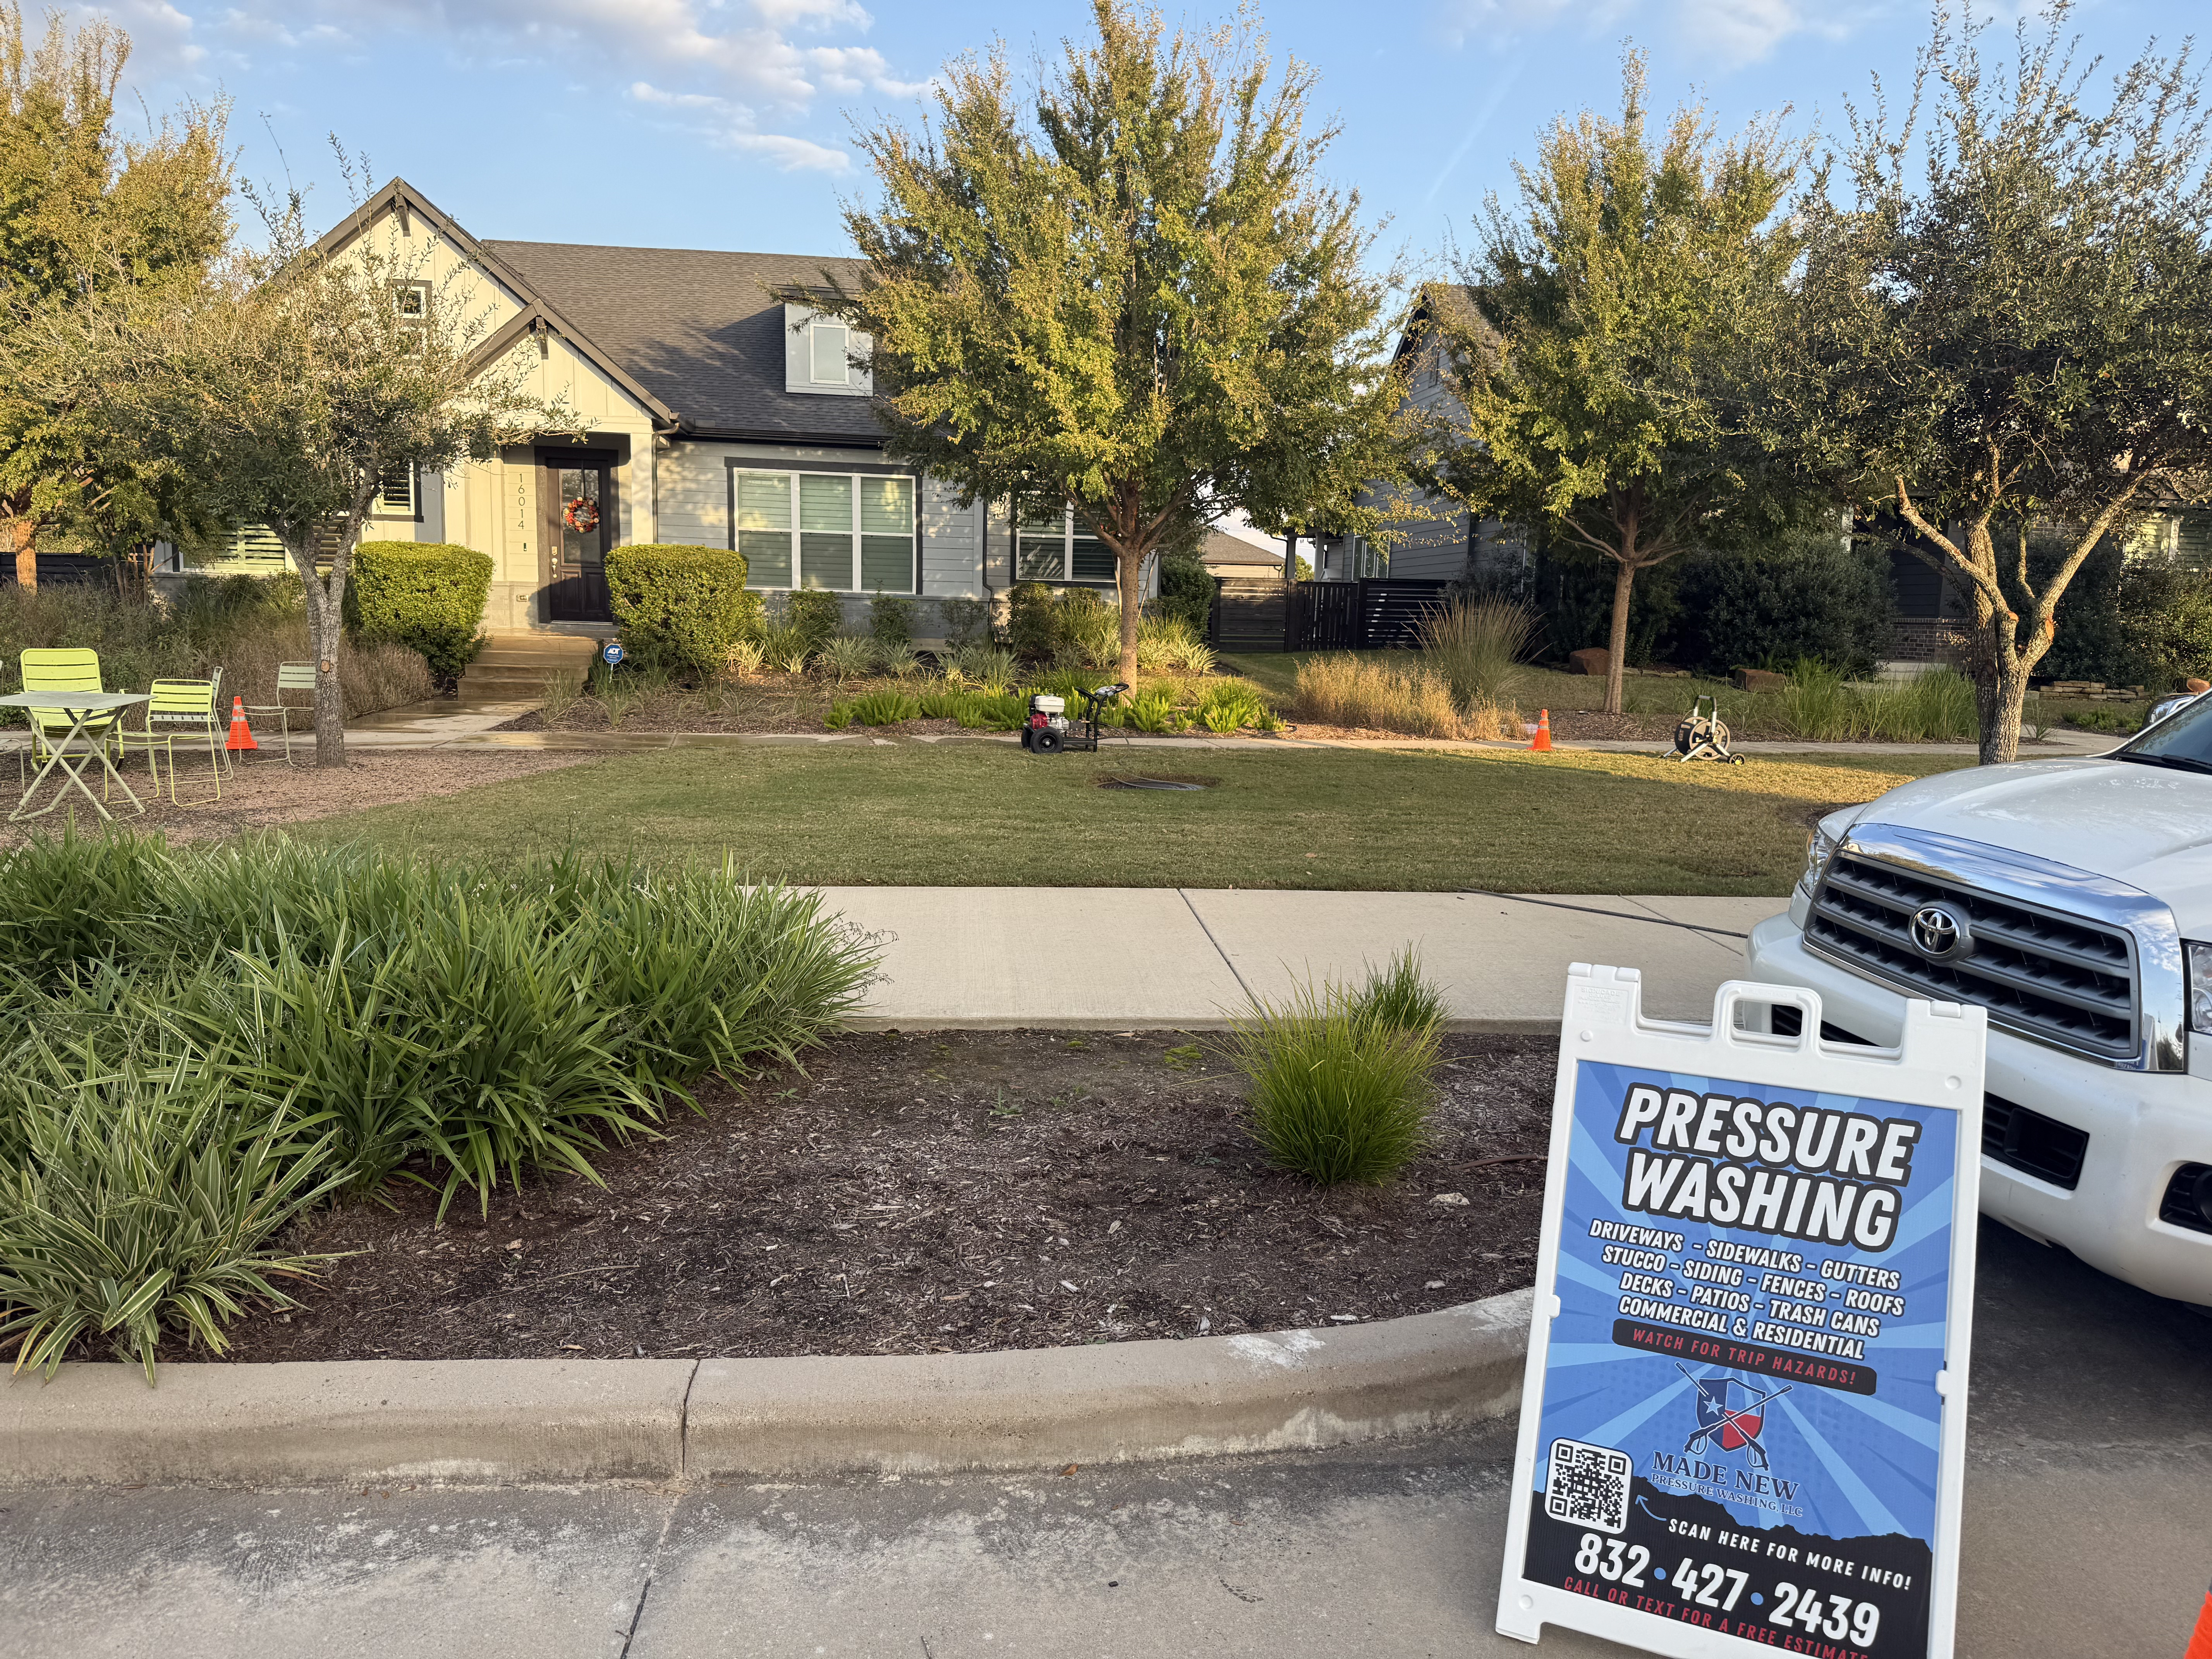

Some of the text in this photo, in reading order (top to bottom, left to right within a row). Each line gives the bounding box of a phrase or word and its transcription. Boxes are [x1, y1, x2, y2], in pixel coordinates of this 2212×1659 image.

[1620, 1087, 1915, 1180] PRESSURE
[1627, 1152, 1895, 1246] WASHING
[1589, 1219, 1683, 1252] DRIVEWAYS
[1706, 1240, 1802, 1272] SIDEWALKS
[1821, 1260, 1899, 1290] GUTTERS
[1602, 1245, 1666, 1272] STUCCO
[1683, 1260, 1742, 1286] SIDING
[1761, 1274, 1826, 1301] FENCES
[1845, 1289, 1905, 1316] ROOFS
[1619, 1296, 1864, 1358] COMMERCIAL & RESIDENTIAL
[1620, 1273, 1673, 1297] DECKS
[1690, 1286, 1750, 1312] PATIOS
[1770, 1300, 1826, 1327] TRASH
[1831, 1311, 1879, 1336] CANS
[1633, 1328, 1856, 1385] WATCH FOR TRIP HAZARDS!
[1651, 1474, 1803, 1517] PRESSURE WASHING, LLC
[1652, 1451, 1799, 1500] MADE NEW
[1669, 1518, 1911, 1590] SCAN HERE FOR MORE INFO!
[1564, 1576, 1599, 1598] CALL
[1607, 1588, 1628, 1605] OR
[1636, 1595, 1675, 1617] TEXT
[1681, 1607, 1712, 1627] FOR
[1718, 1618, 1728, 1632] A
[1736, 1622, 1777, 1645] FREE
